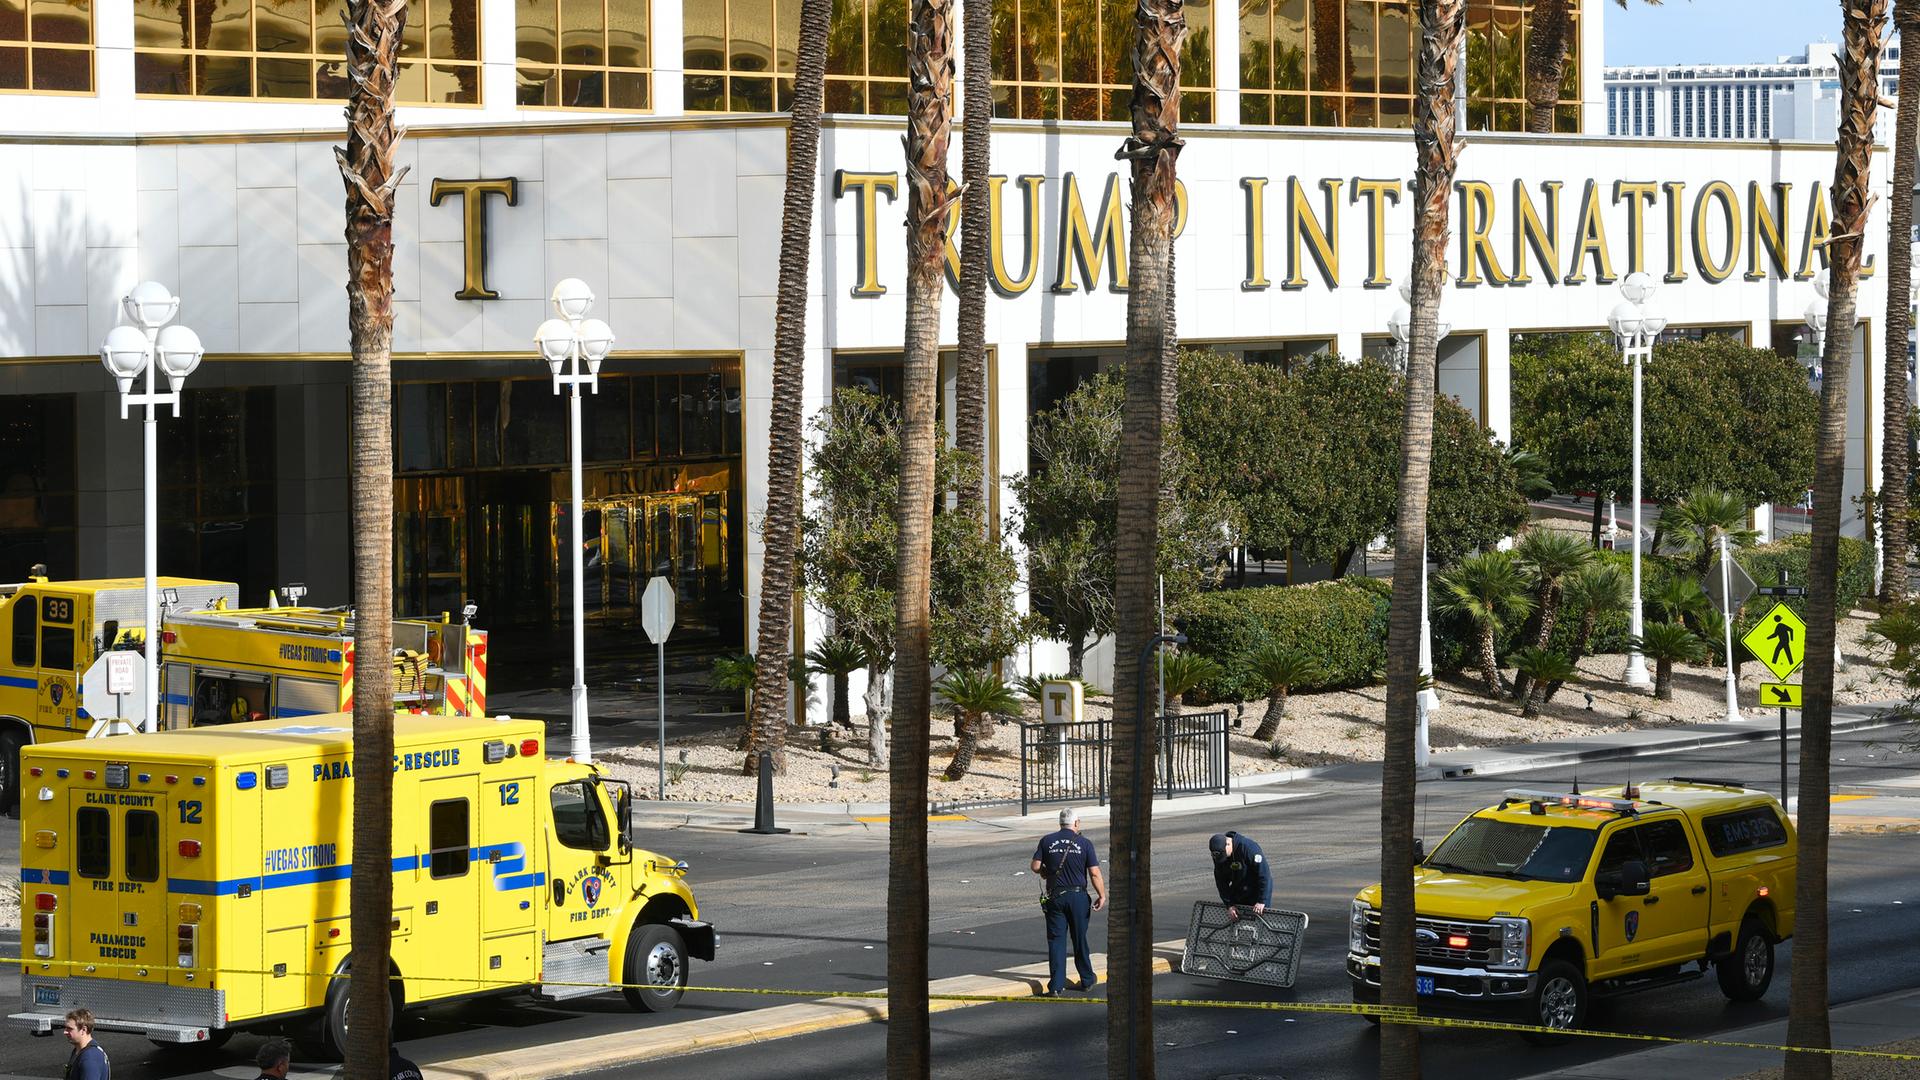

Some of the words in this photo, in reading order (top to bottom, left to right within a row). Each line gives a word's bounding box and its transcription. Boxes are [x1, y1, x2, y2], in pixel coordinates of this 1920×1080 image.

[430, 176, 518, 300] T
[834, 168, 1188, 300] TUM
[1239, 174, 1875, 293] INTRNATIONA
[604, 466, 679, 494] TRUMP
[49, 600, 69, 619] 33
[279, 643, 302, 661] #VEGAS
[303, 646, 328, 664] STRONG
[38, 705, 53, 714] FIRE
[1049, 691, 1067, 716] T
[86, 793, 117, 805] CLARK
[119, 795, 155, 808] COUNTY
[499, 782, 520, 807] 12
[178, 799, 203, 825] 12
[265, 845, 300, 873] #VEGAS
[301, 843, 336, 869] STRONG
[93, 881, 114, 892] FIRE
[118, 882, 145, 894] DEPT.
[567, 865, 589, 896] CLARK
[591, 865, 617, 889] COUNTY
[570, 910, 588, 923] FIRE
[591, 907, 612, 920] DEPT.
[90, 932, 146, 948] PARAMEDIC
[99, 948, 137, 960] RESCUE
[1424, 979, 1433, 994] 33
